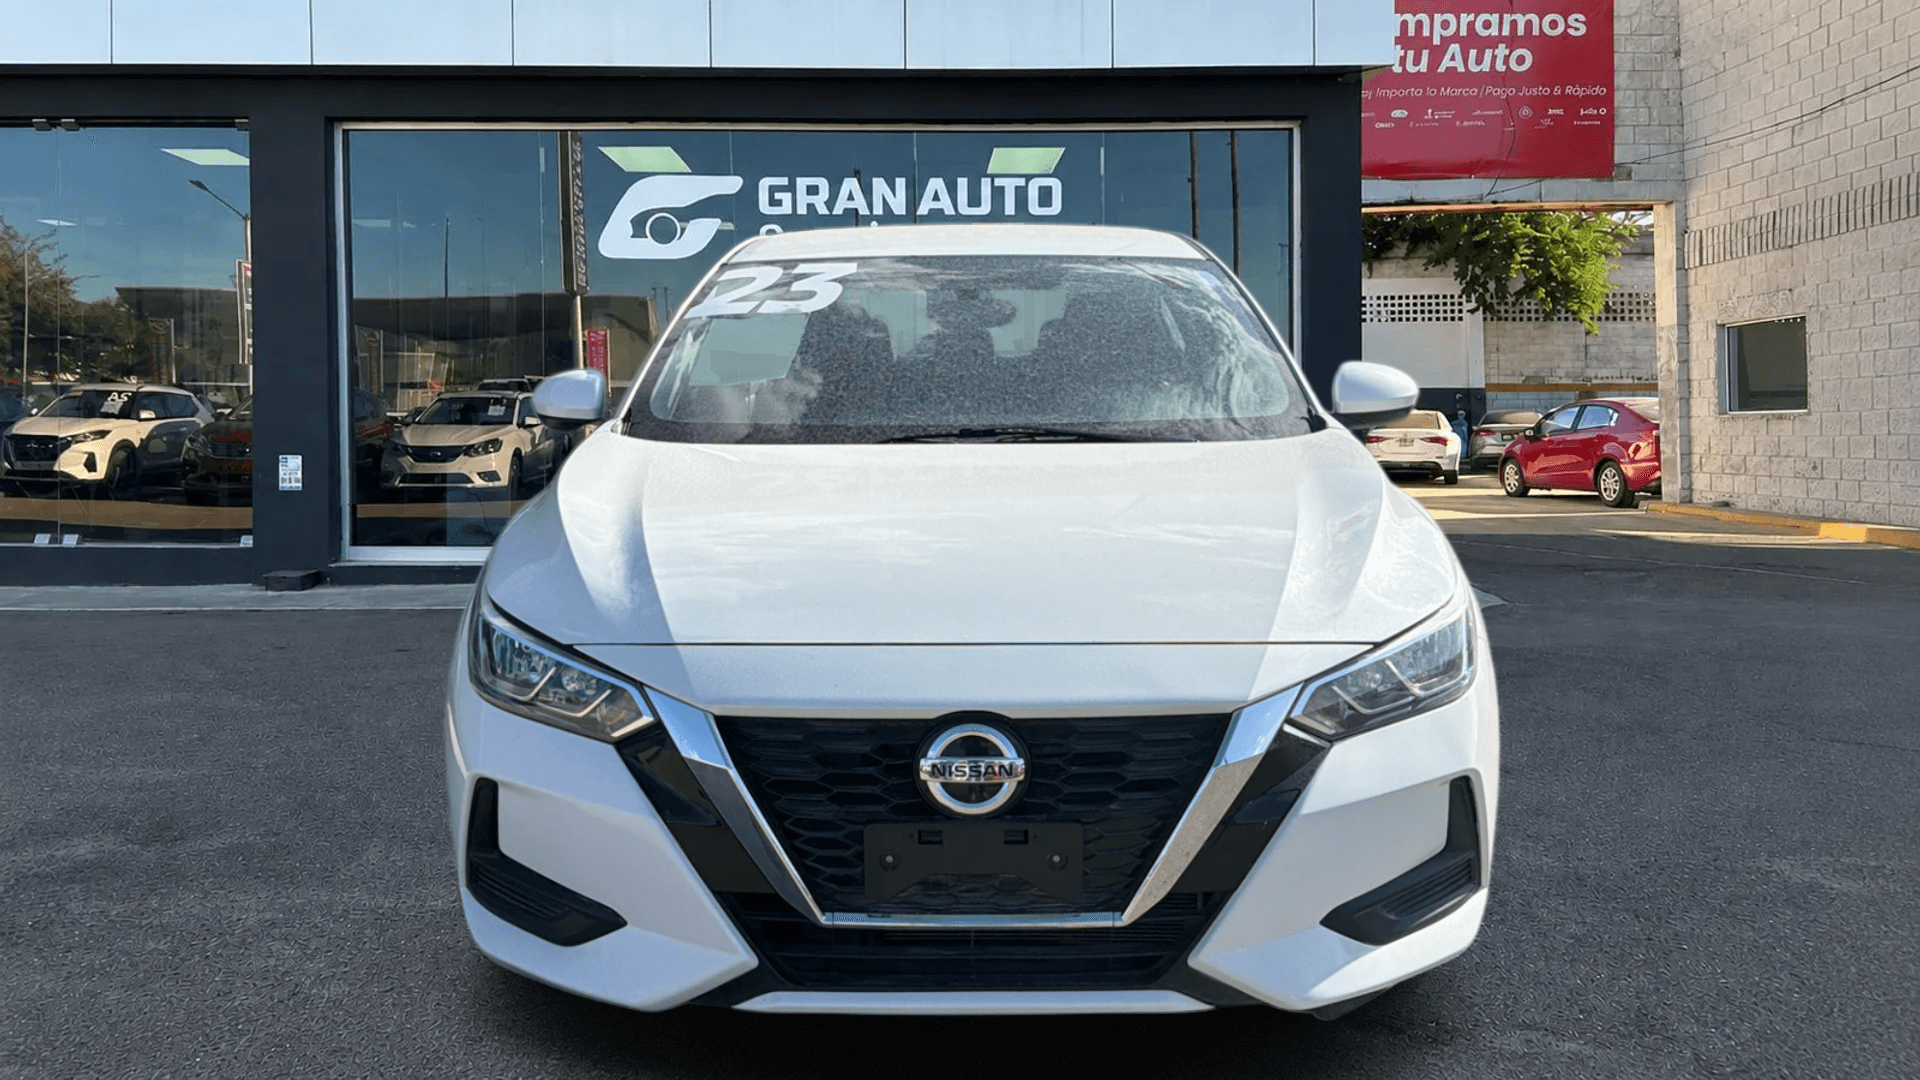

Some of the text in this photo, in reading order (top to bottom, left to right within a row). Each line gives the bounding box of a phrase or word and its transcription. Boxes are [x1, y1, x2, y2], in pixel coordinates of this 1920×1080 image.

[1392, 43, 1533, 73] tu Auto
[1376, 88, 1423, 99] Importa
[1440, 86, 1478, 97] Marca
[1519, 86, 1551, 96] Justo
[1565, 84, 1607, 98] Rápido
[758, 176, 1063, 216] GRAN AUTO
[682, 262, 858, 320] 23
[931, 763, 1014, 778] NISSAN
